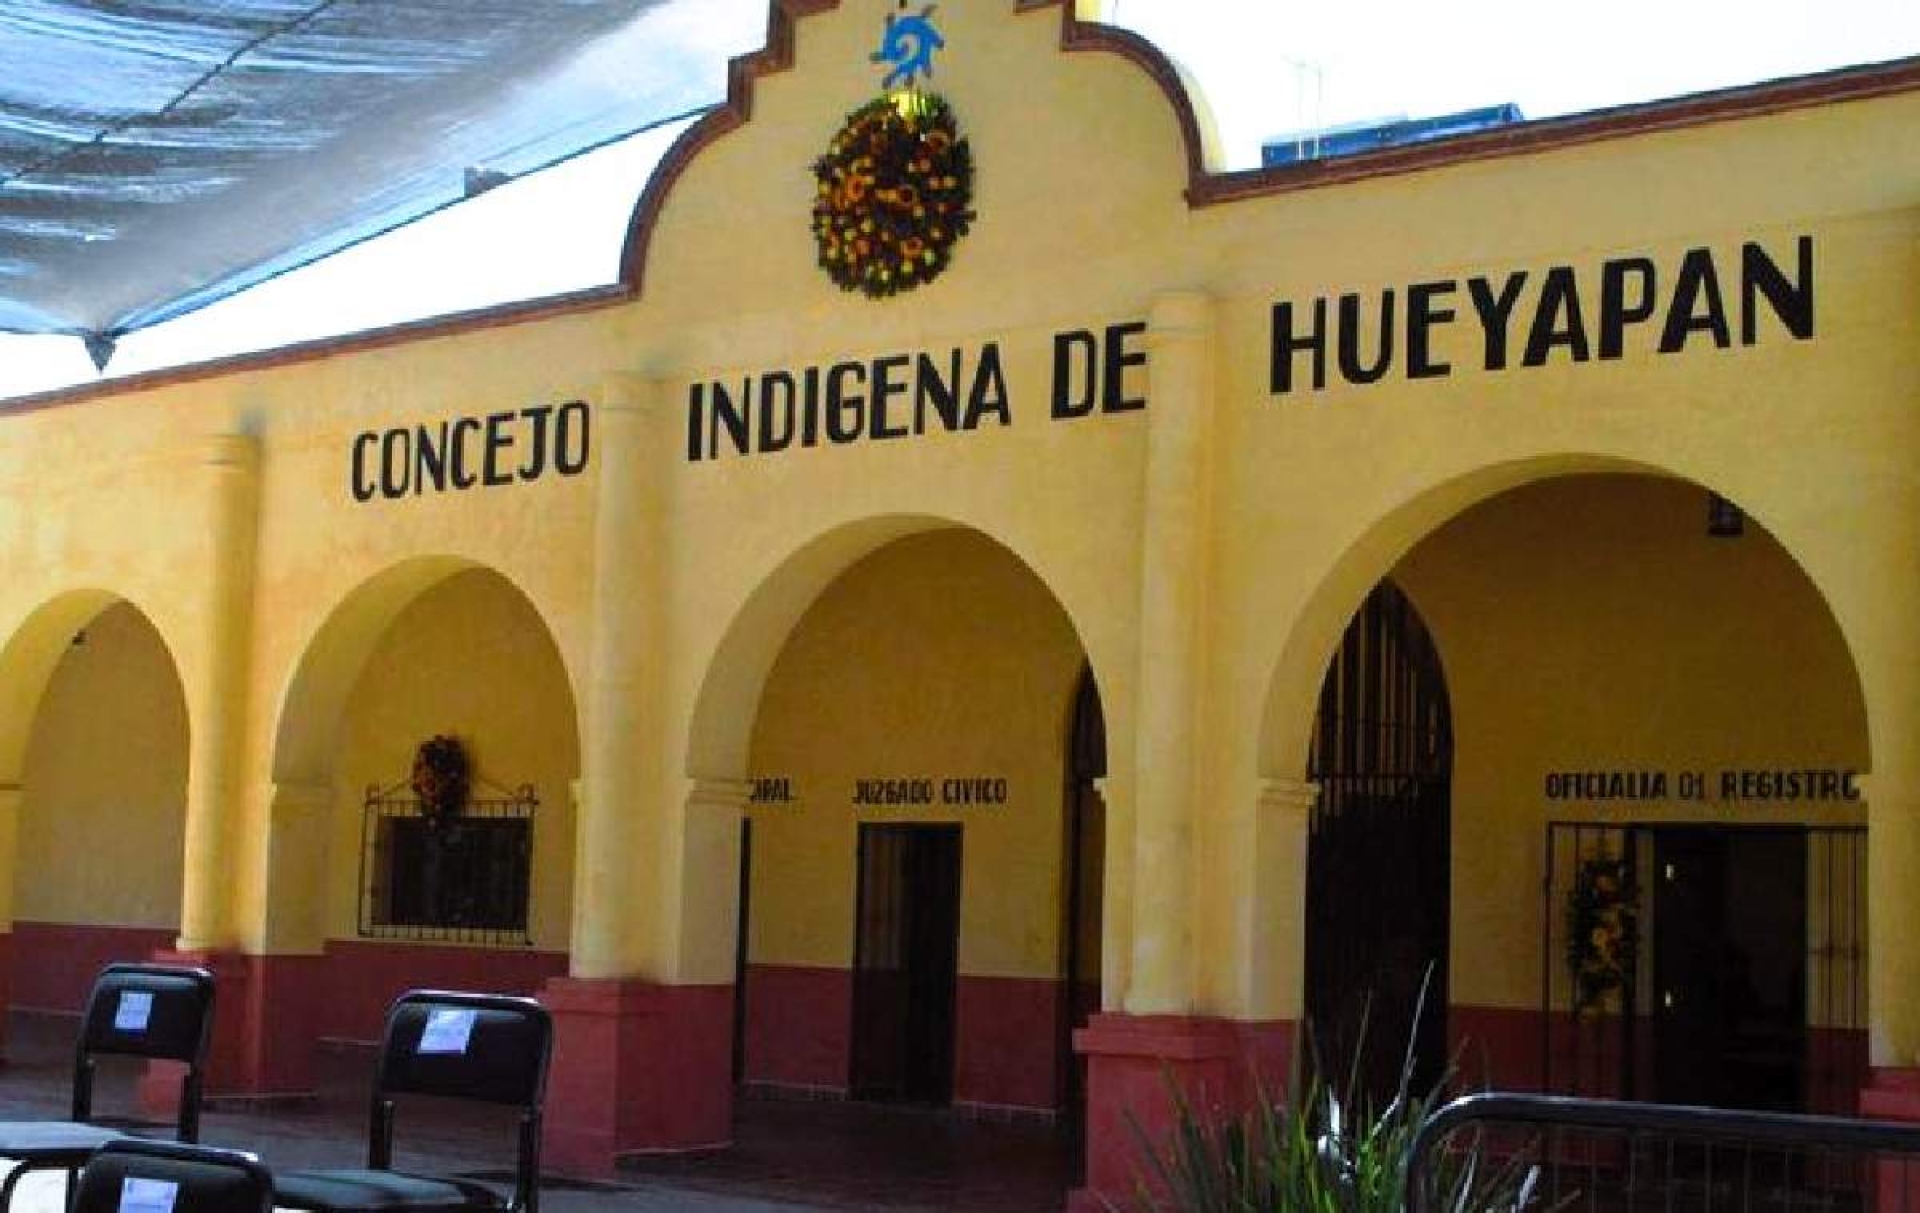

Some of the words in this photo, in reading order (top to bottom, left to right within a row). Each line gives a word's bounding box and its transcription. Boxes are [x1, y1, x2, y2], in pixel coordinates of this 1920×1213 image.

[352, 400, 590, 501] CONCEJO
[687, 341, 1012, 462] INDIGENA
[1050, 321, 1147, 421] DE
[1270, 235, 1814, 395] HUEYAPAN
[852, 777, 935, 805] JUZGADO
[942, 777, 1008, 805] CIVICO
[1545, 769, 1670, 801] OFICIALIA
